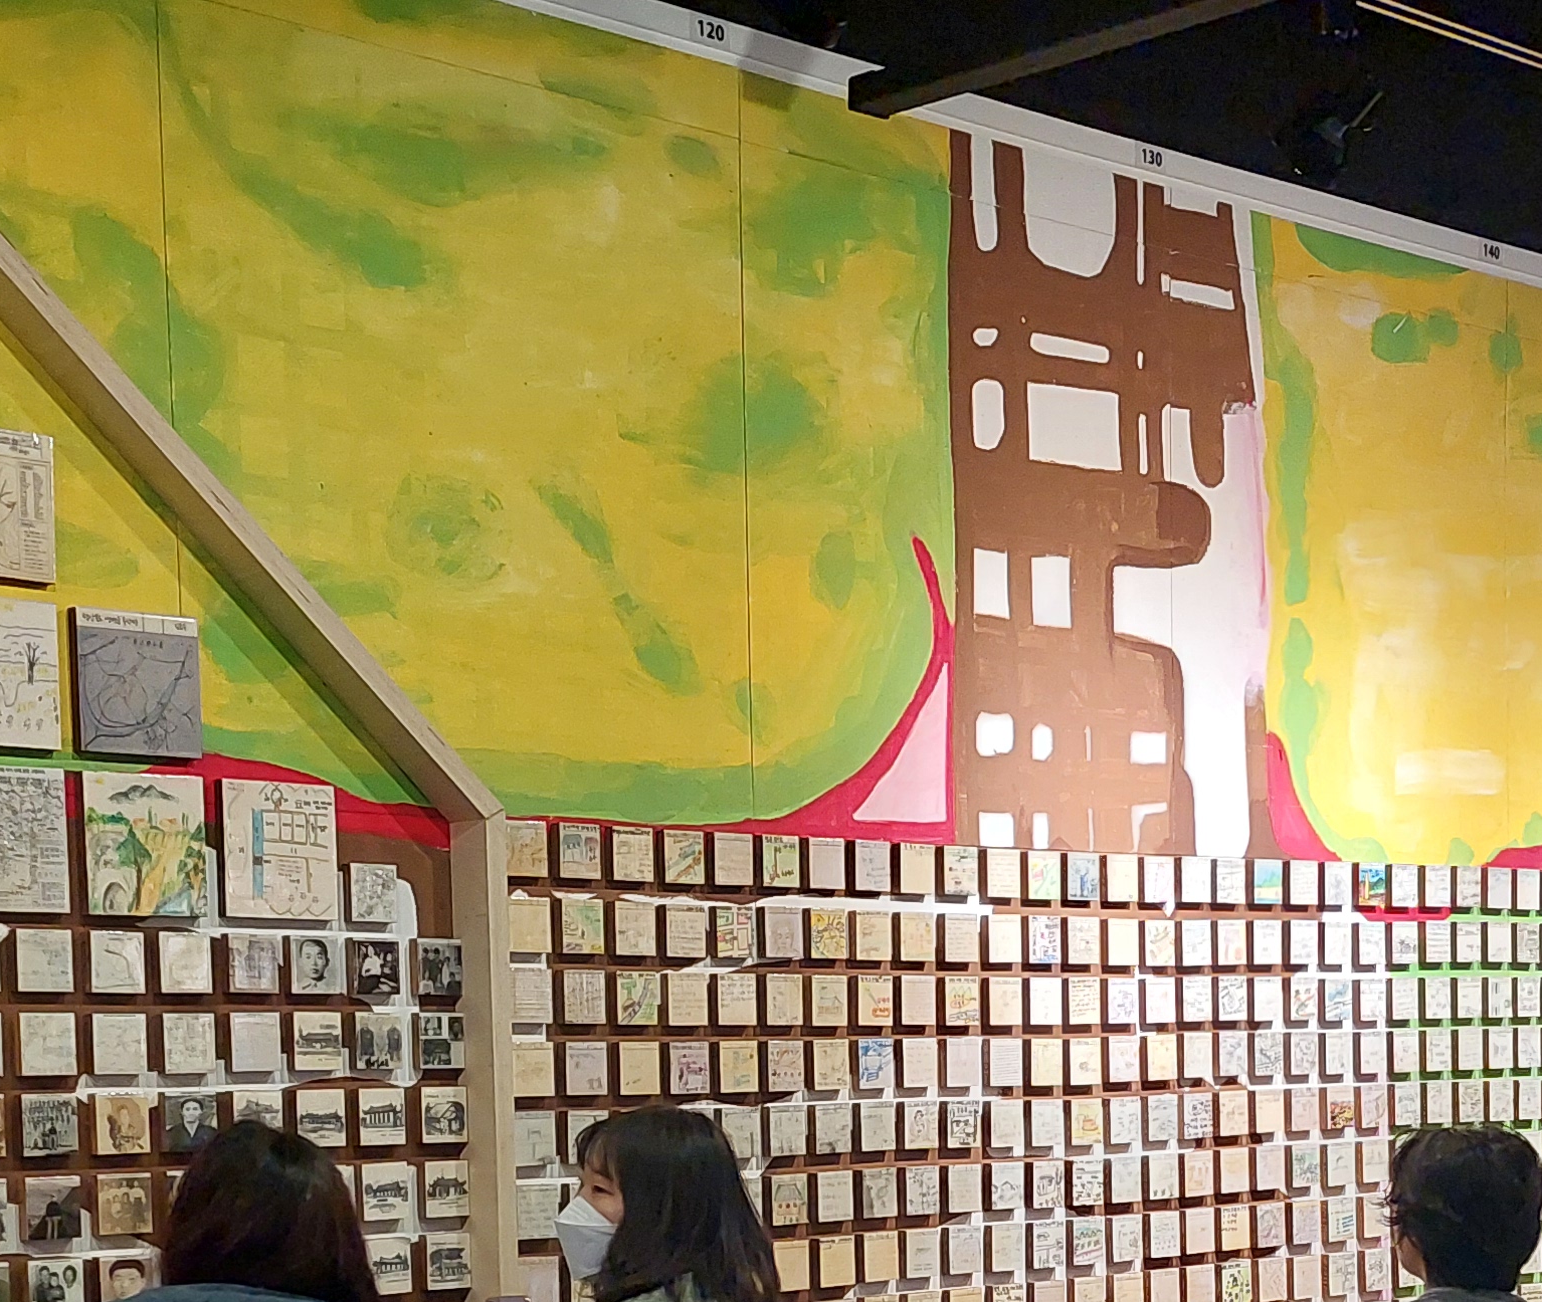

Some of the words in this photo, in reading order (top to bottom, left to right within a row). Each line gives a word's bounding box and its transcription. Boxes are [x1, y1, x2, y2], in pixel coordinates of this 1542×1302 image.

[697, 19, 725, 42] 120
[1141, 148, 1163, 168] 130
[1483, 243, 1500, 260] 140
